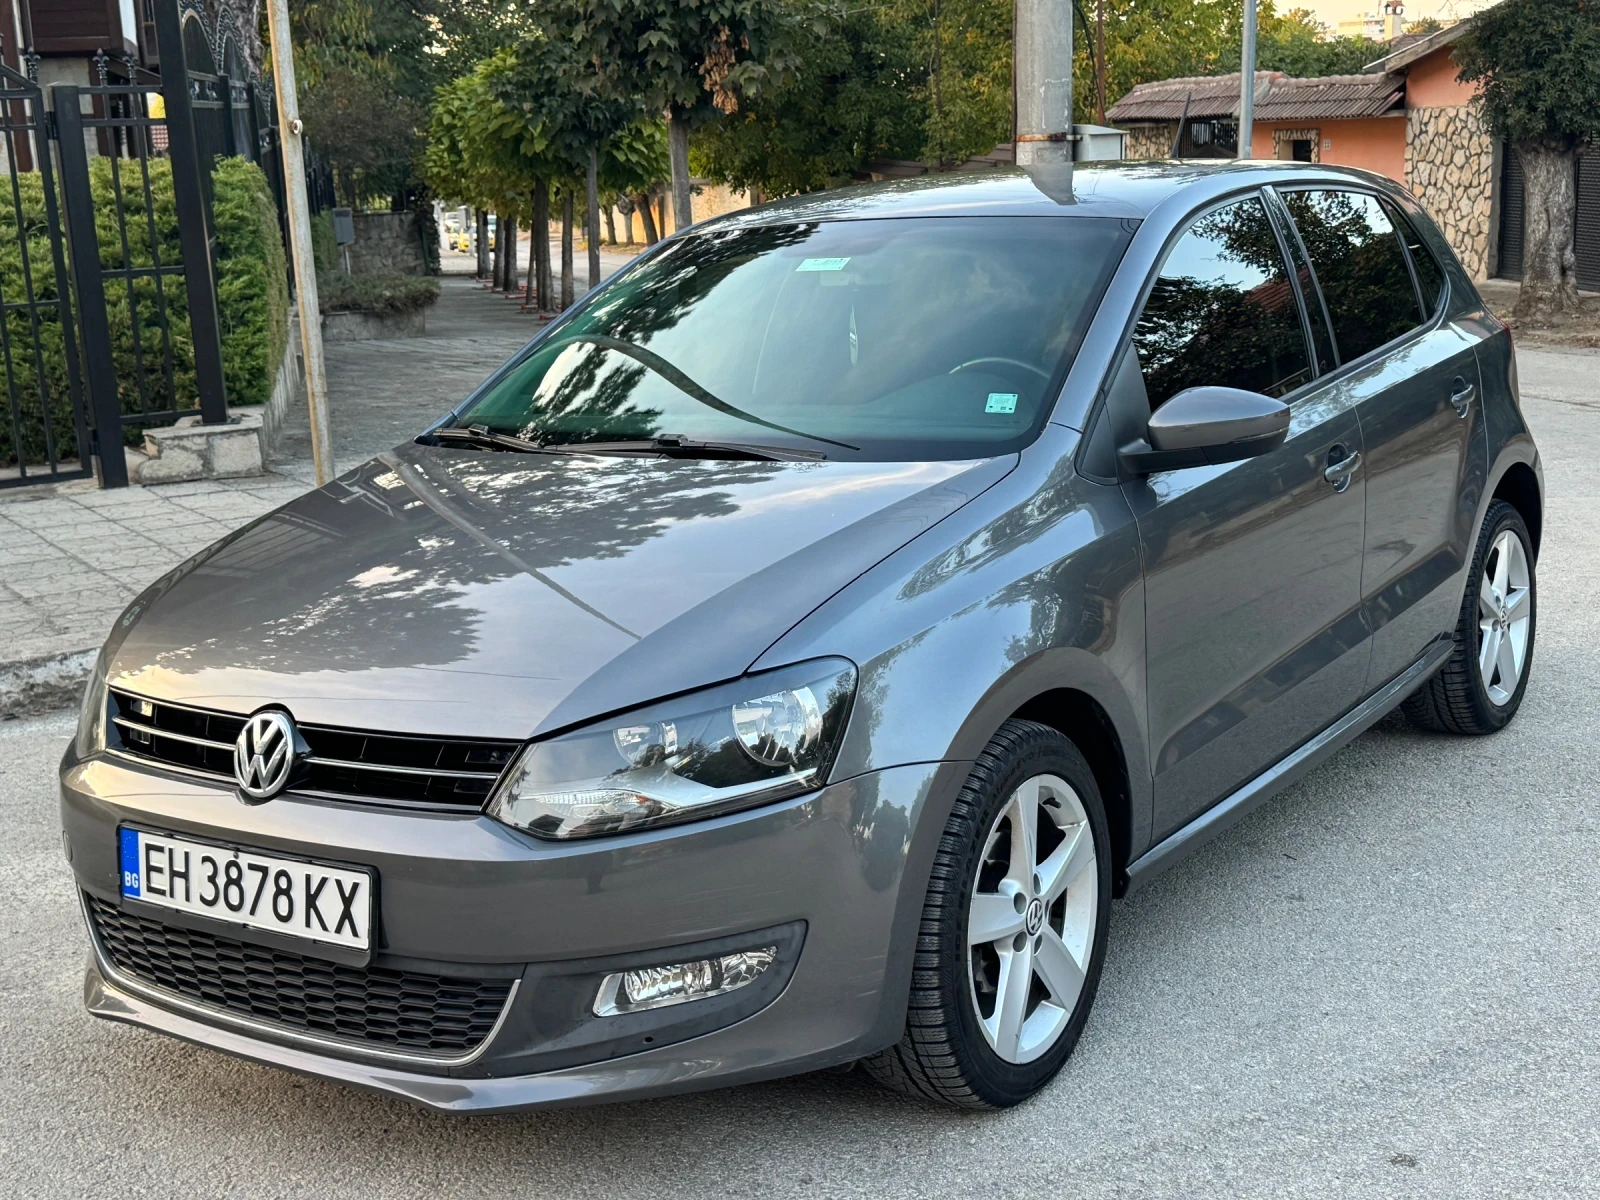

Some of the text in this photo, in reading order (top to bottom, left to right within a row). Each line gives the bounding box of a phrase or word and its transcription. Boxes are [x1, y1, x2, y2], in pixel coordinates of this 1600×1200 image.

[237, 712, 292, 796] VW
[124, 870, 139, 888] BG
[199, 856, 294, 923] 3878
[304, 873, 360, 938] KX
